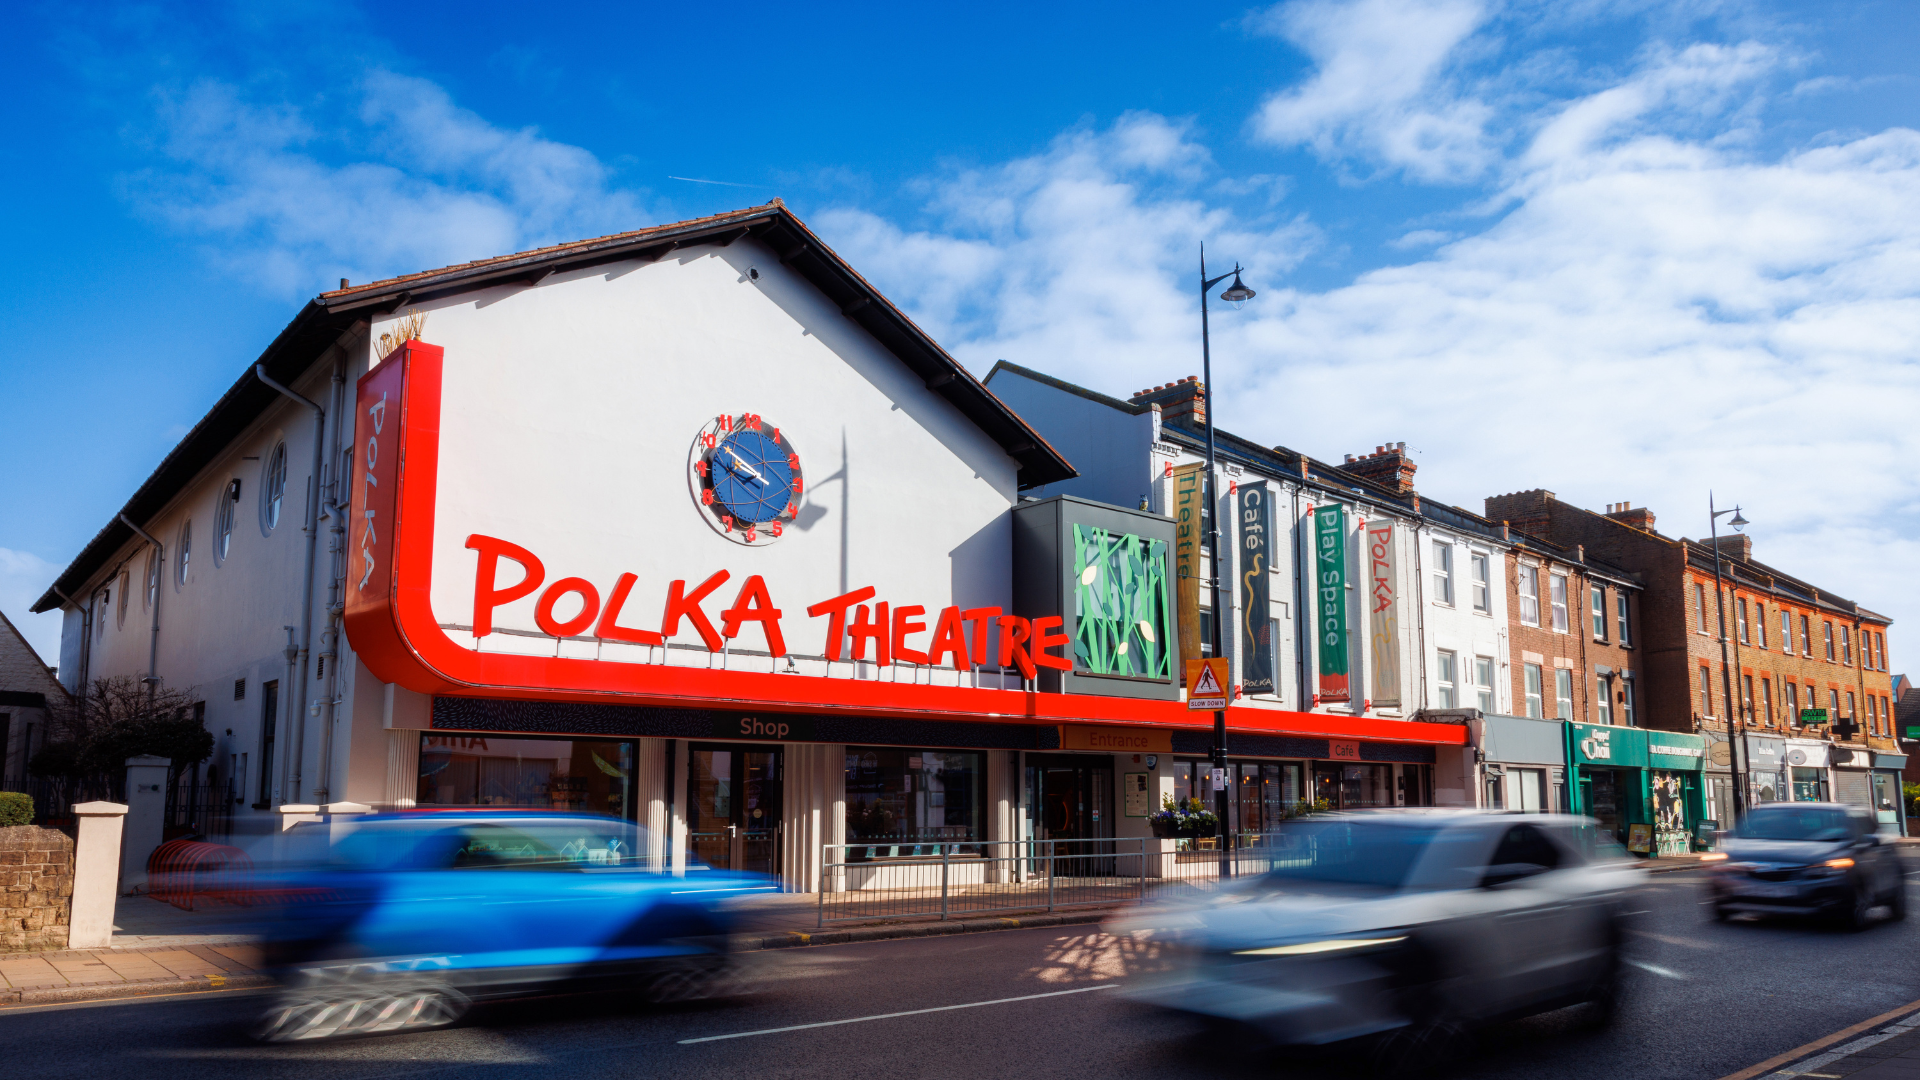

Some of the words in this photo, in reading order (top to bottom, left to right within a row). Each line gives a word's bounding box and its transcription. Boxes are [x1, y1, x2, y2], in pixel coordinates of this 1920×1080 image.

[719, 414, 733, 432] 11
[744, 412, 761, 430] 12
[701, 431, 716, 449] 10
[774, 428, 780, 444] 1
[696, 460, 707, 477] 9
[789, 453, 800, 470] 2
[359, 391, 387, 592] POLKA
[792, 477, 803, 493] 3
[702, 488, 714, 505] 8
[787, 502, 798, 519] 4
[722, 515, 733, 532] 7
[1177, 470, 1197, 580] Theatre
[1244, 488, 1264, 551] Café
[747, 526, 757, 541] 6
[772, 520, 783, 537] 5
[1319, 511, 1338, 564] Play
[1369, 525, 1393, 613] POLKA
[465, 534, 786, 658] POLKA
[807, 585, 1073, 680] THEATRE
[1320, 570, 1340, 646] Space
[1243, 678, 1272, 688] POLKA
[1320, 687, 1348, 697] POLKA
[1803, 709, 1825, 717] SW19
[740, 717, 789, 739] Shop
[1090, 732, 1148, 748] Entrance
[1335, 744, 1354, 757] Café
